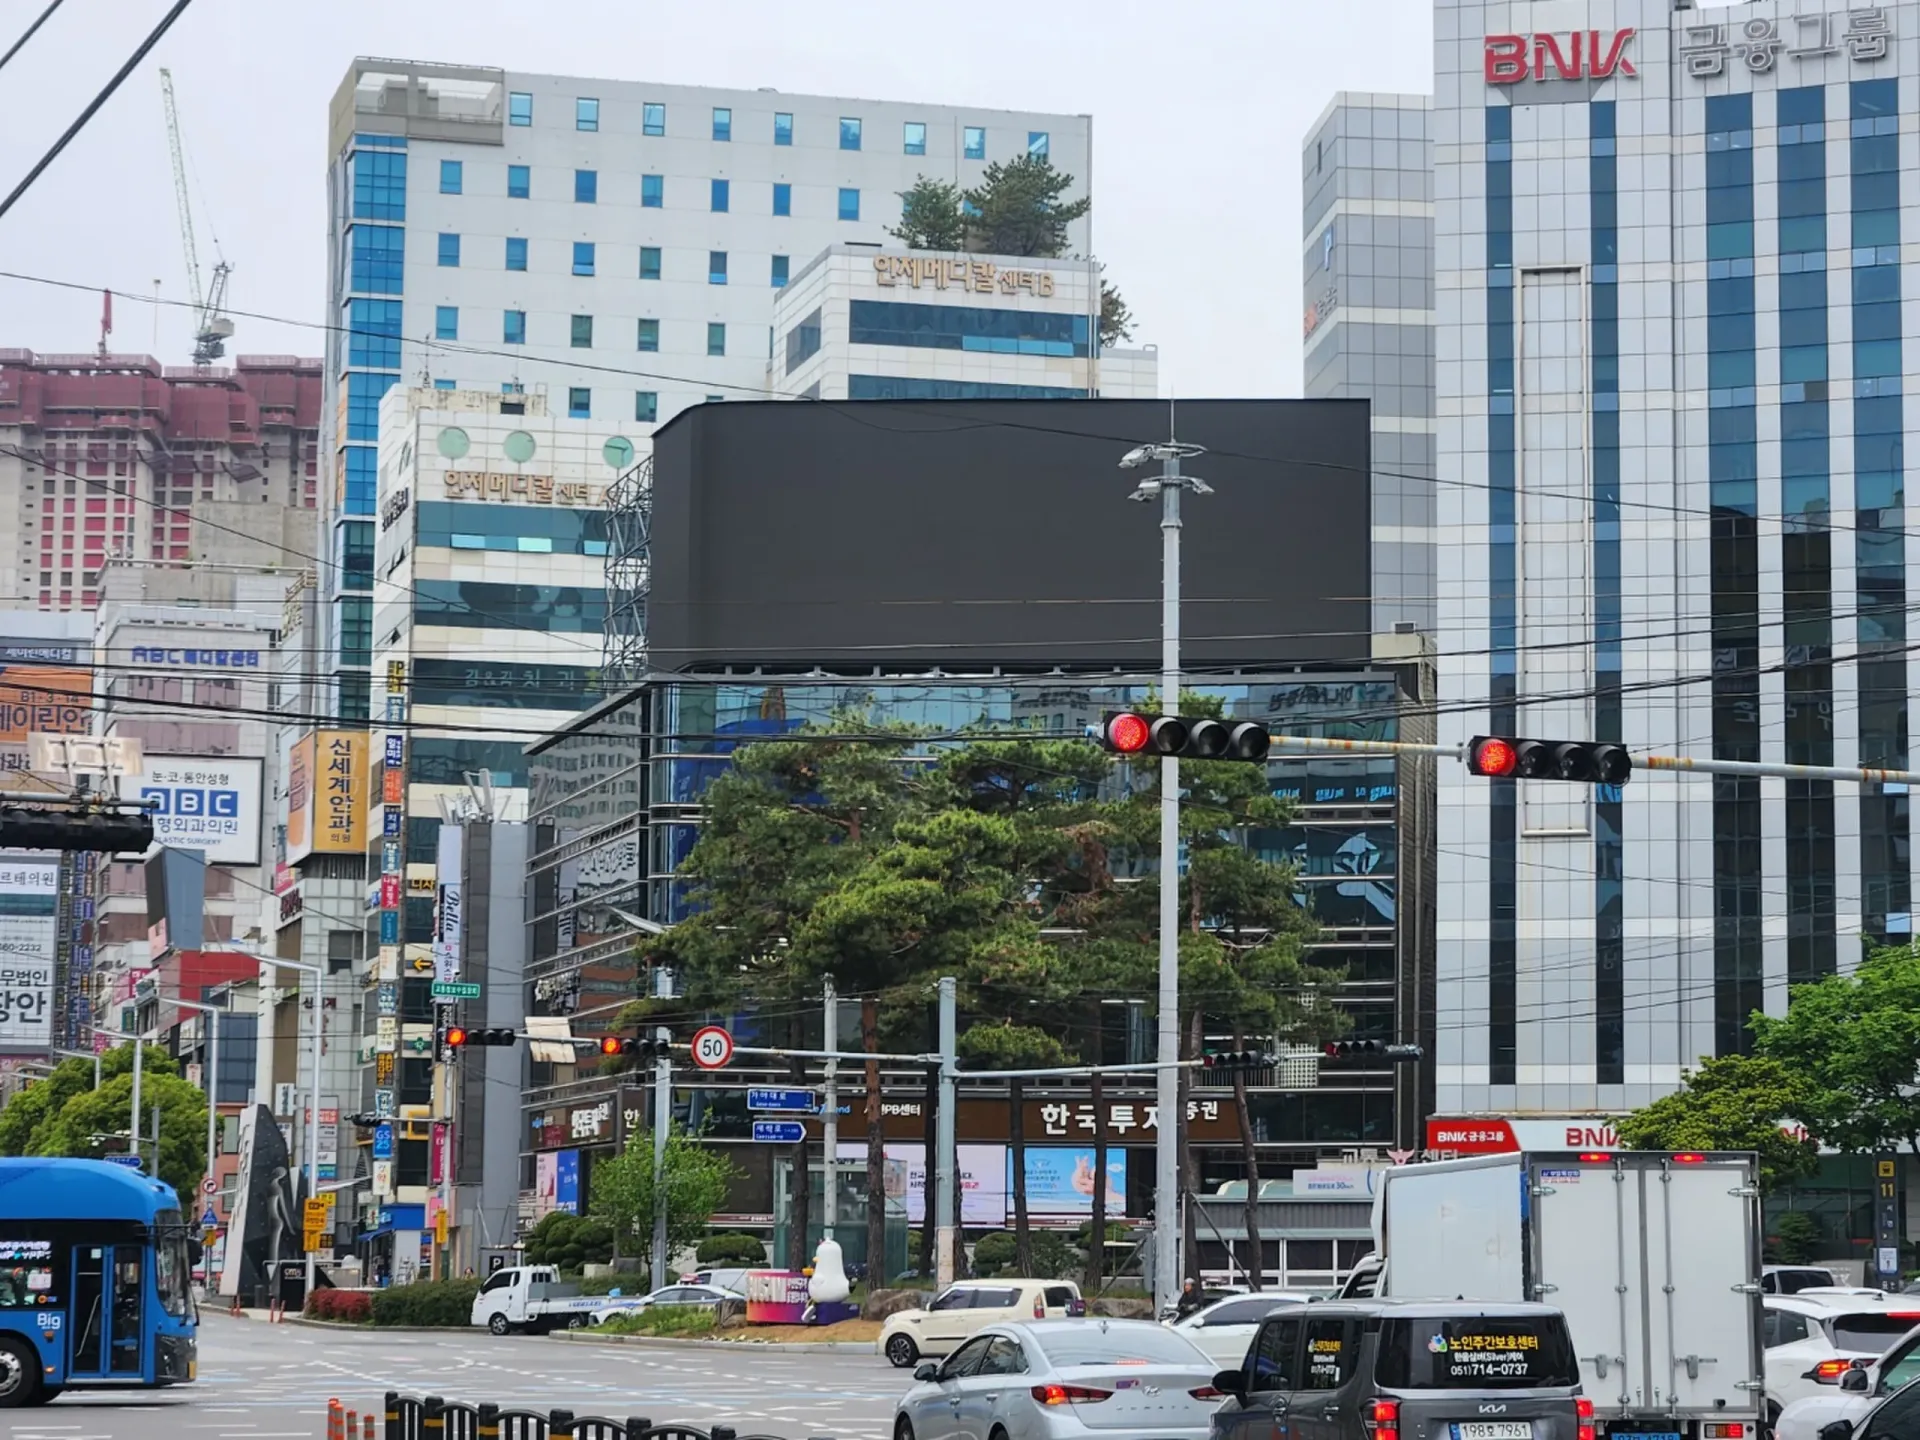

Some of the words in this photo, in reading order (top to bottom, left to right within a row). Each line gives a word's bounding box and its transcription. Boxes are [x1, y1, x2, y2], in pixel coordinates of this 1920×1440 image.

[1484, 28, 1638, 84] BNK
[1678, 6, 1892, 77] 금융그룹
[328, 738, 354, 833] 신세계안과
[447, 891, 459, 931] Bella
[702, 1039, 722, 1057] 50
[376, 1130, 391, 1140] GS
[1437, 1131, 1467, 1142] BNK
[1468, 1131, 1506, 1142] 금융그룹
[1881, 1183, 1894, 1198] 11
[37, 1313, 61, 1330] Big
[1449, 1335, 1539, 1350] 노인주간보호센터
[1498, 1424, 1528, 1438] 7961
